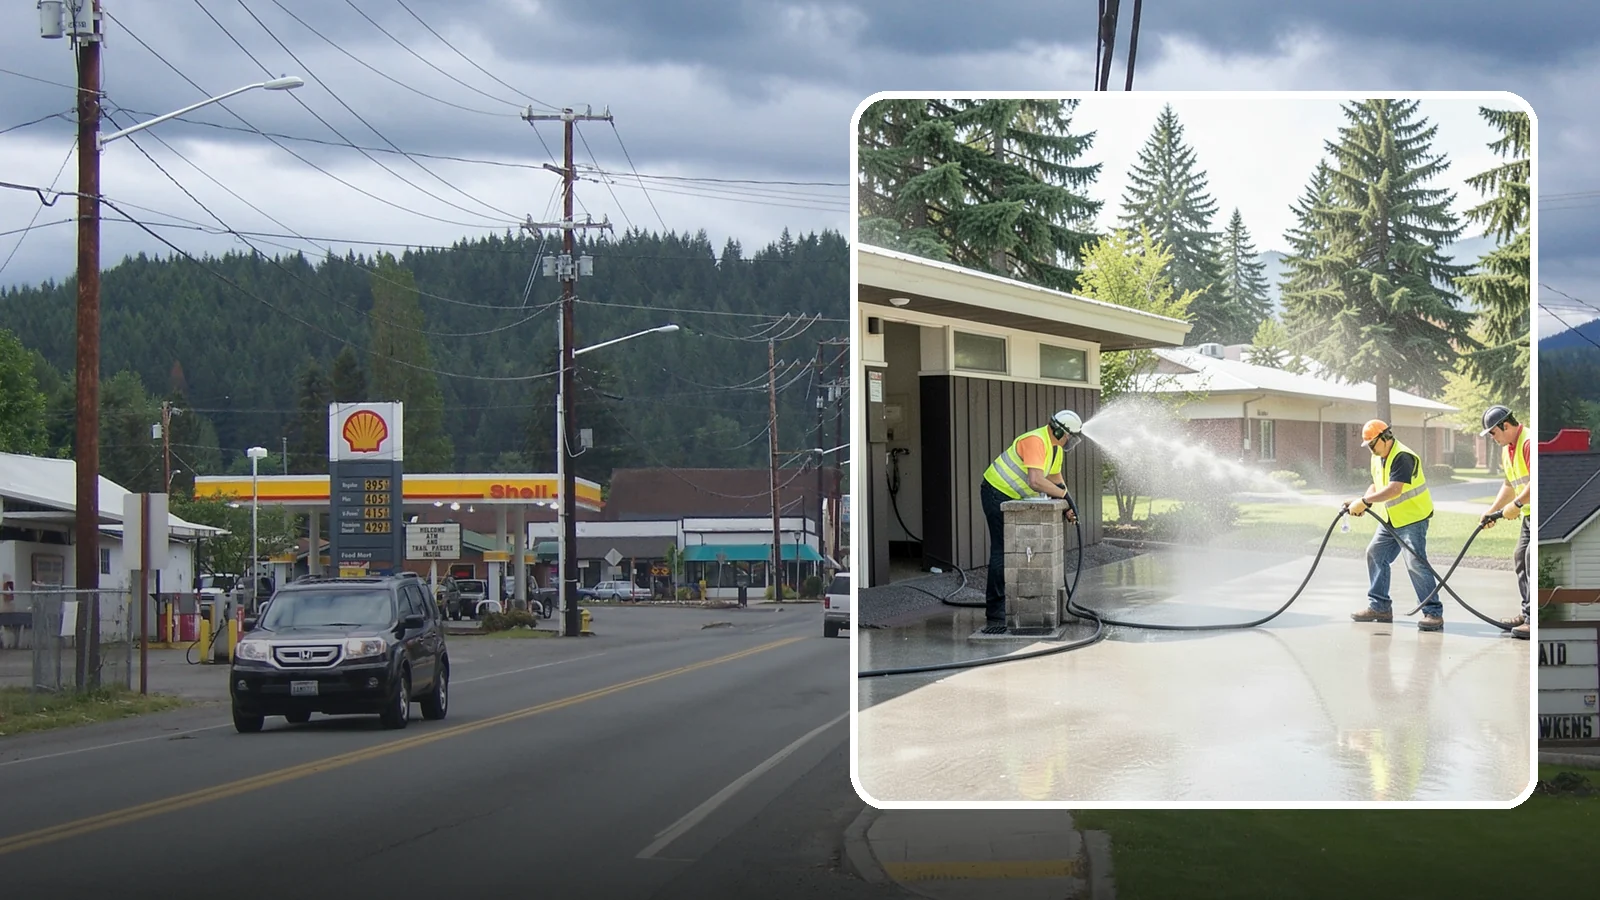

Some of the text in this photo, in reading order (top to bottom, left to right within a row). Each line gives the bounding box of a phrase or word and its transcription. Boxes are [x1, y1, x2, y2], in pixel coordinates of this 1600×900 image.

[366, 480, 383, 490] 395
[490, 484, 547, 499] Shell
[365, 494, 383, 504] 405
[366, 508, 383, 518] 415
[366, 522, 383, 532] 429
[1538, 643, 1566, 665] AID
